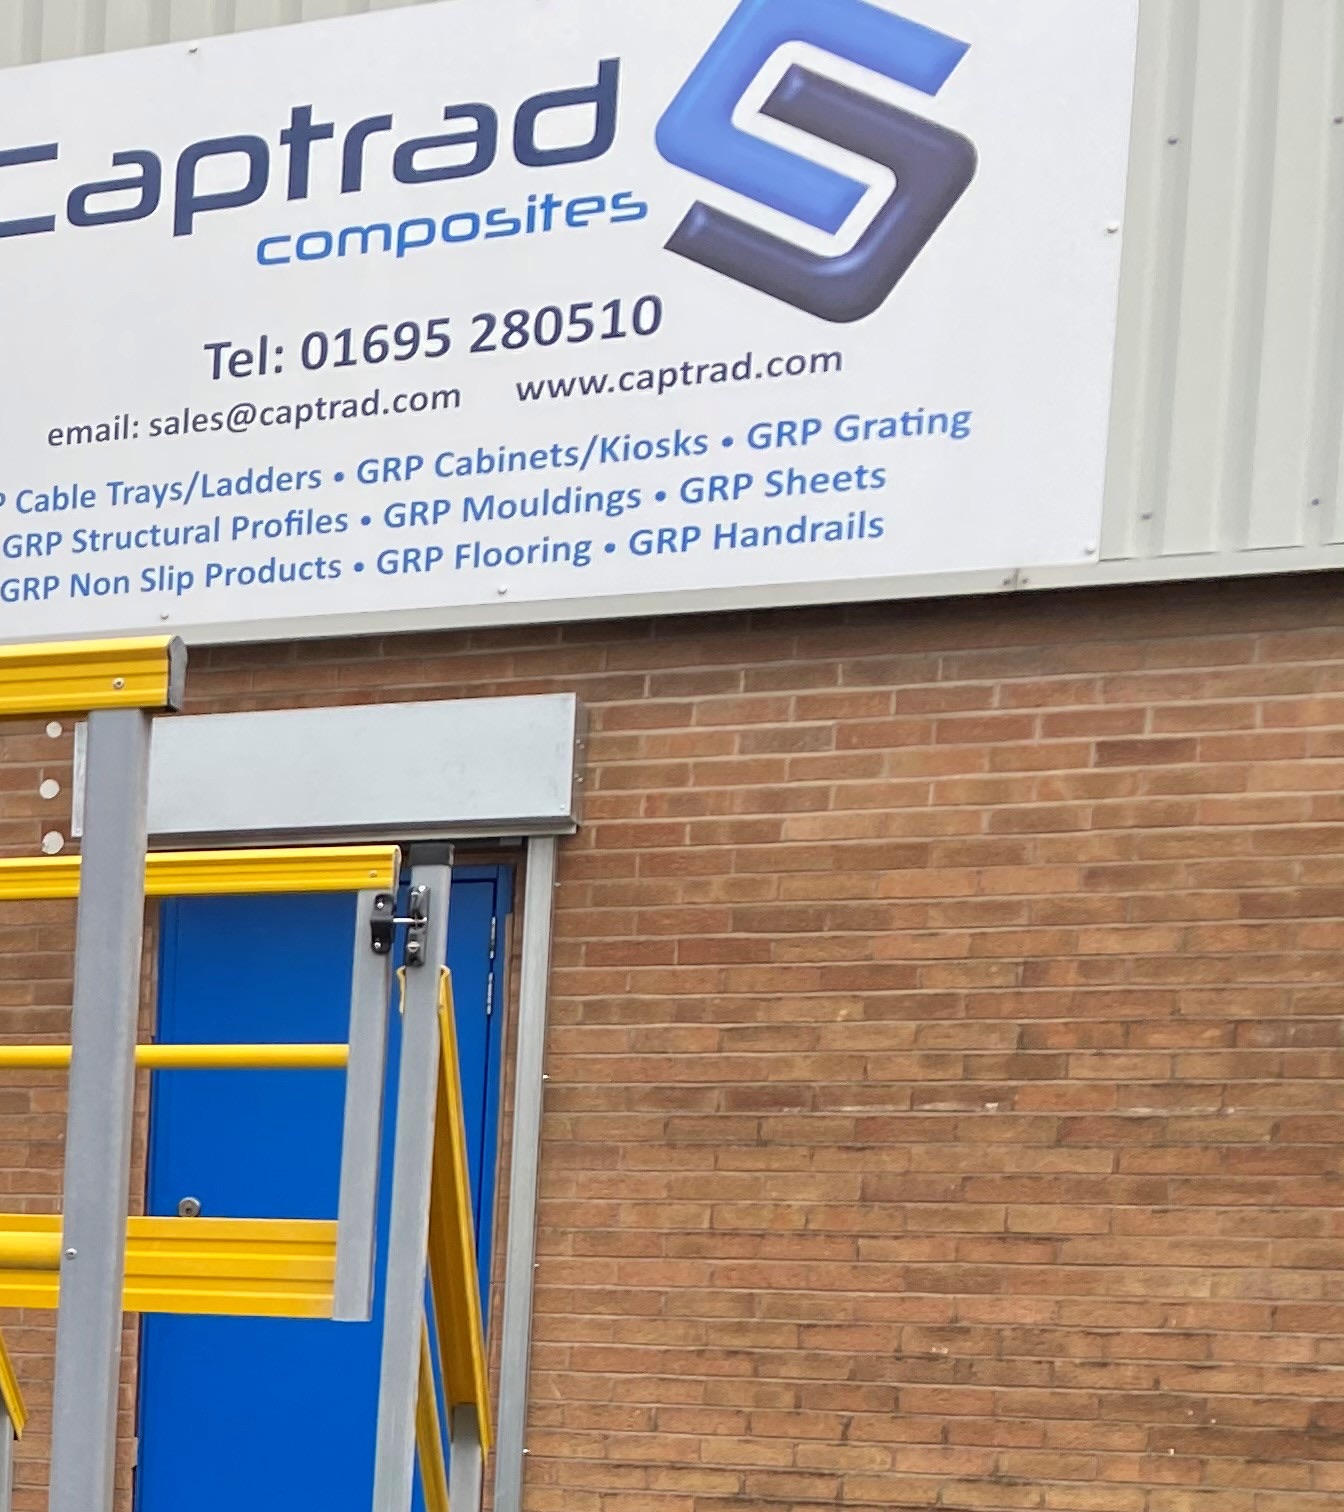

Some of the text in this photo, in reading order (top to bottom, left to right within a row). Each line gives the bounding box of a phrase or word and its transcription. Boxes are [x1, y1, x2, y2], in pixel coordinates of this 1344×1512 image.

[256, 190, 649, 266] composites
[203, 294, 663, 381] Tel: 01695 280510
[515, 350, 843, 402] www.captrad.com
[15, 483, 97, 515] Cable
[105, 465, 322, 510] Trays/Ladders
[356, 454, 425, 485] GRP
[434, 428, 709, 479] Cabinets/Kiosks
[746, 417, 823, 451] GRP
[833, 406, 973, 443] Grating
[47, 387, 461, 447] email: sales@captrad.com
[2, 464, 887, 559] GRP Structural Profiles GRP Mouldings GRP Sheets
[0, 509, 885, 603] GRP Non Slip Products GRP Flooring GRP Handrails
